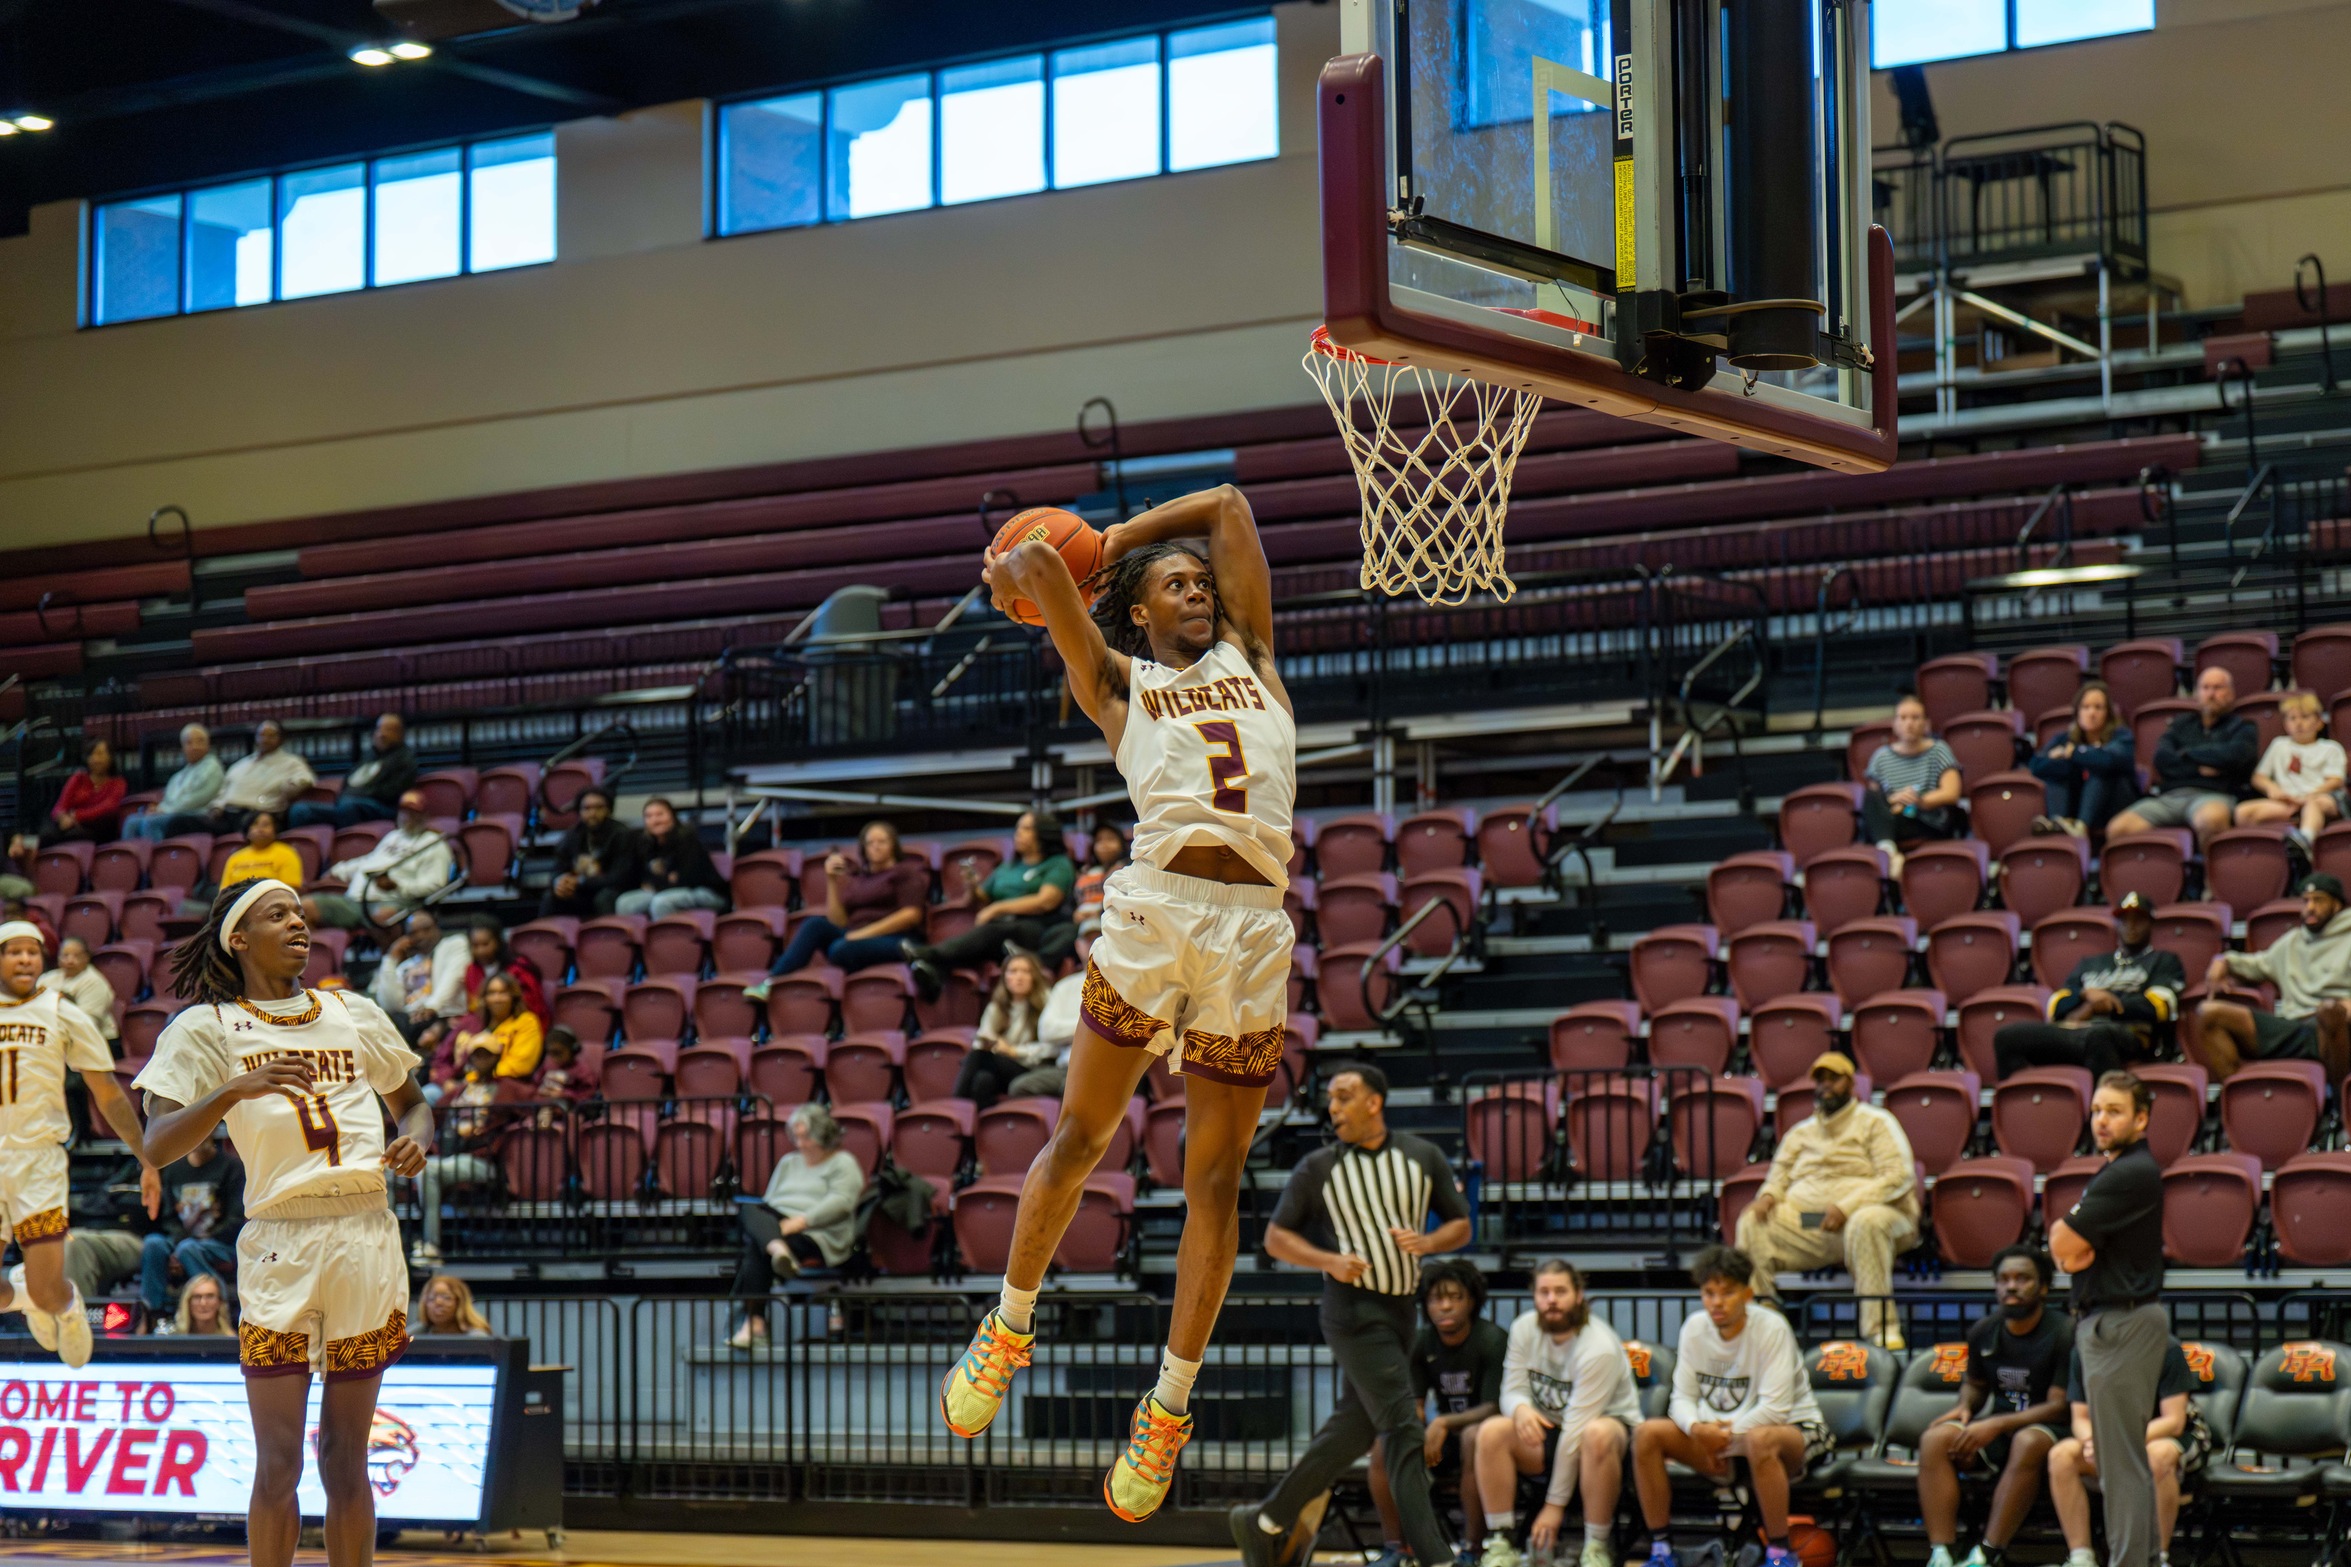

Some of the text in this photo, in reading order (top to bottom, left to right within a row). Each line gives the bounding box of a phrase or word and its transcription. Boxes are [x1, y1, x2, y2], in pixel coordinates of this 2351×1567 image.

[1140, 675, 1266, 722] WILDCATS
[1192, 720, 1251, 814] 2
[286, 1093, 342, 1167] 4
[0, 1380, 175, 1424] OME TO
[0, 1426, 208, 1497] RIVER
